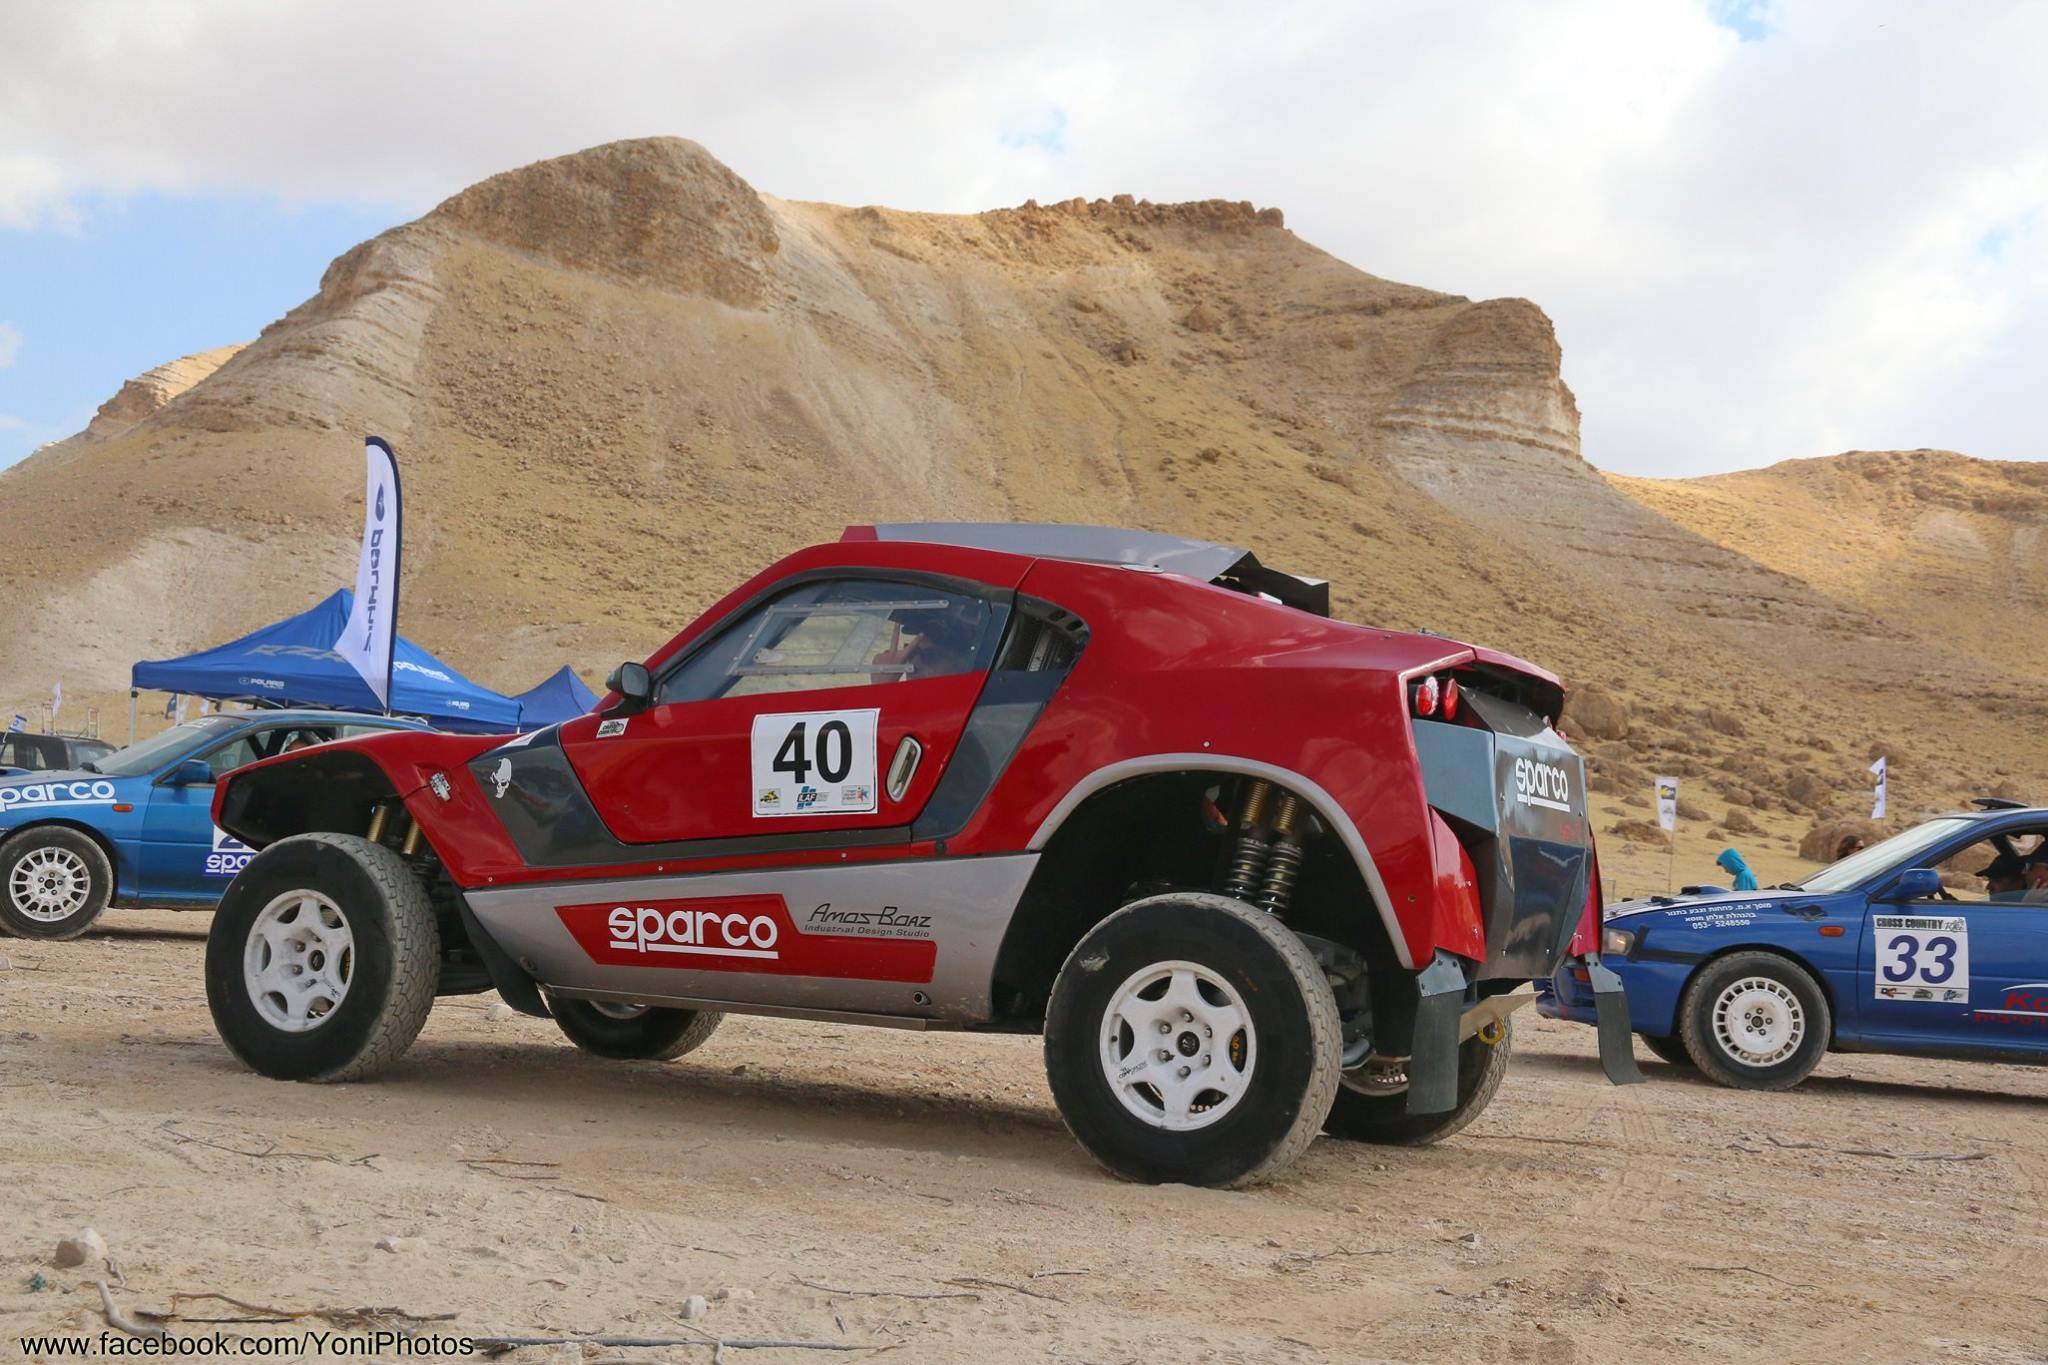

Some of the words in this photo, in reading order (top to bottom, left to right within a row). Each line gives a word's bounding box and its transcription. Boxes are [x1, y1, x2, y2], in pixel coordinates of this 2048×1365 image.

[773, 720, 851, 783] 40
[0, 781, 116, 812] parco
[1516, 757, 1568, 807] sparco
[608, 907, 778, 955] sparco
[804, 924, 854, 933] Industrial
[857, 927, 892, 936] Design
[896, 929, 930, 938] Studio
[1876, 918, 1903, 928] CROSS
[1905, 918, 1943, 929] COUNTRY
[1883, 934, 1957, 984] 33
